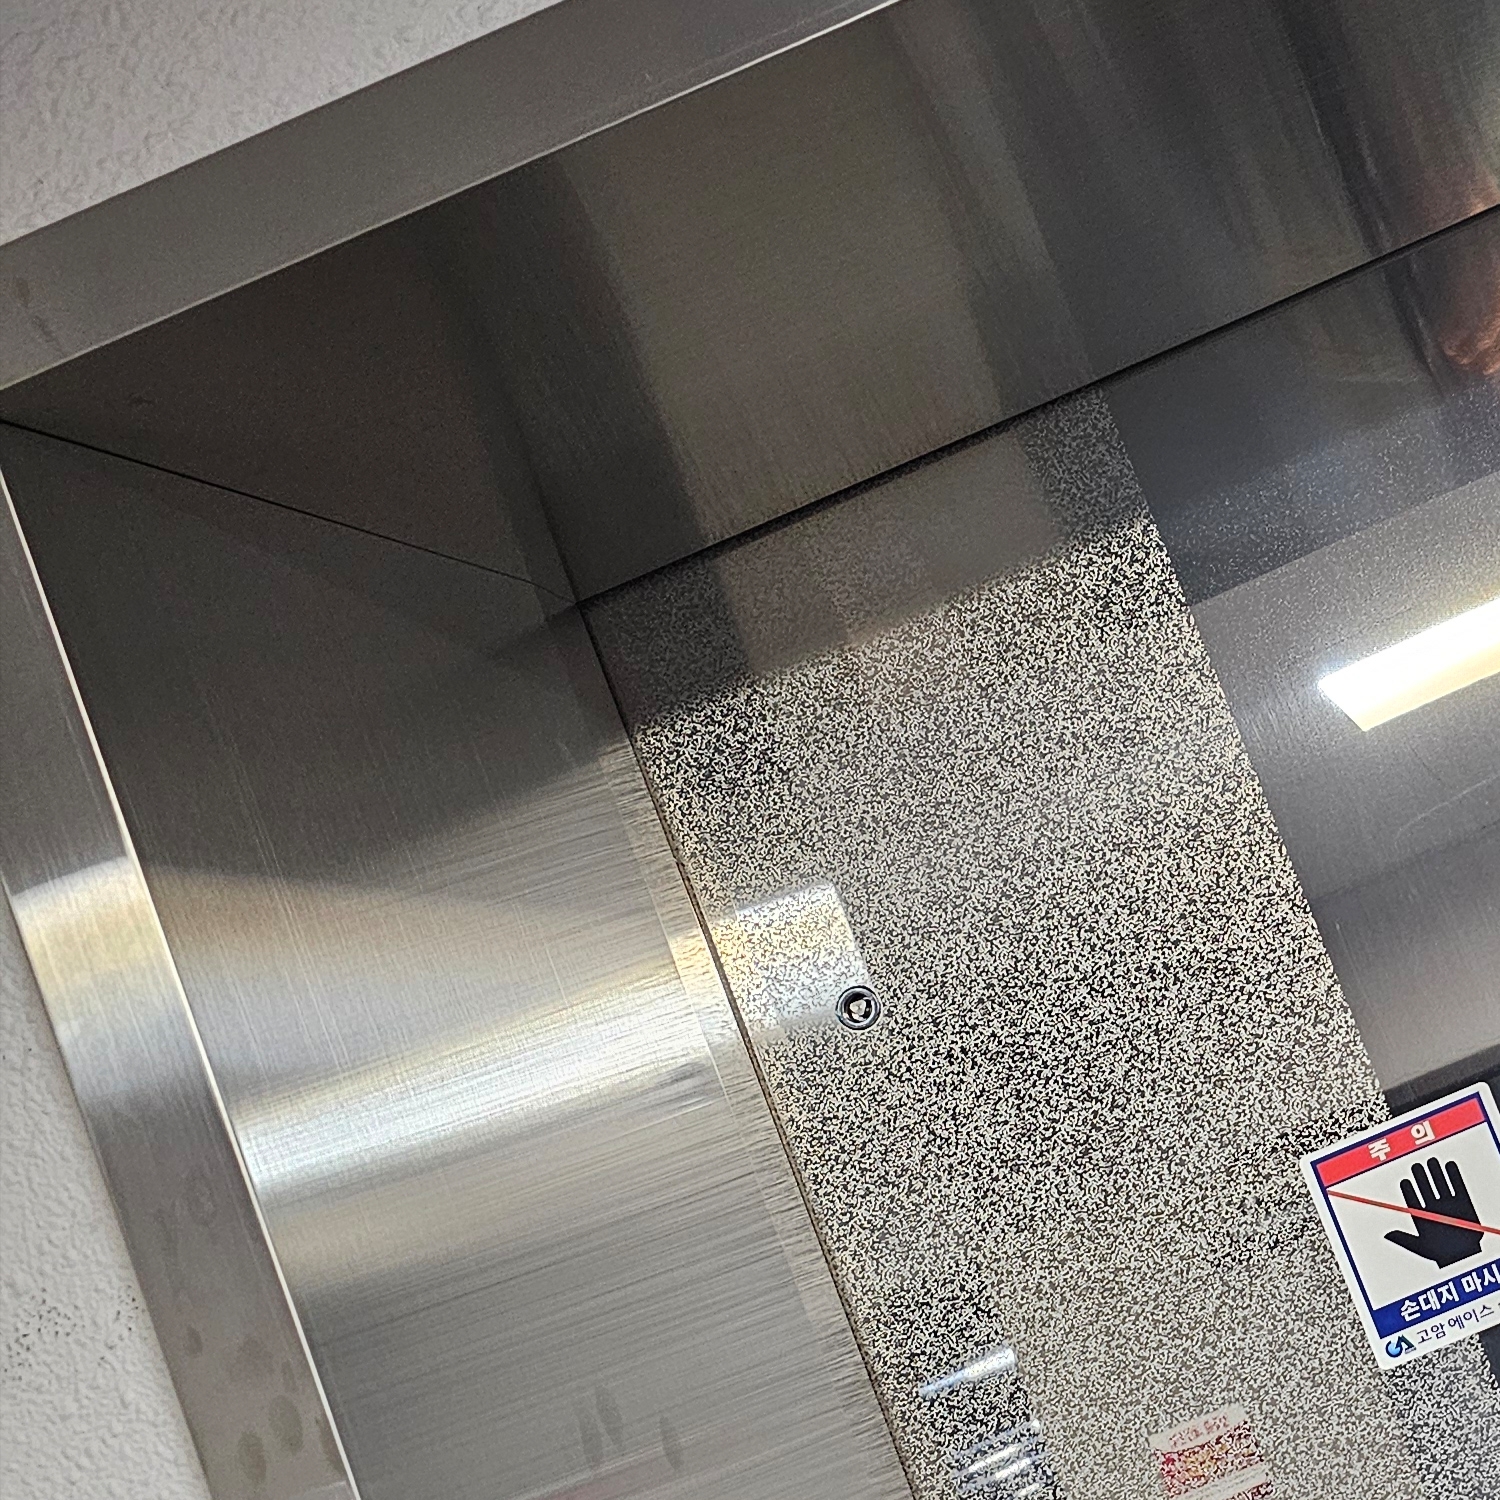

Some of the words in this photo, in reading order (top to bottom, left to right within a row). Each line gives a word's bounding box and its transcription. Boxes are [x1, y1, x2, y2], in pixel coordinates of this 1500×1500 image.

[1367, 1138, 1391, 1161] 주
[1410, 1120, 1436, 1146] 의
[1400, 1281, 1460, 1322] 손대지
